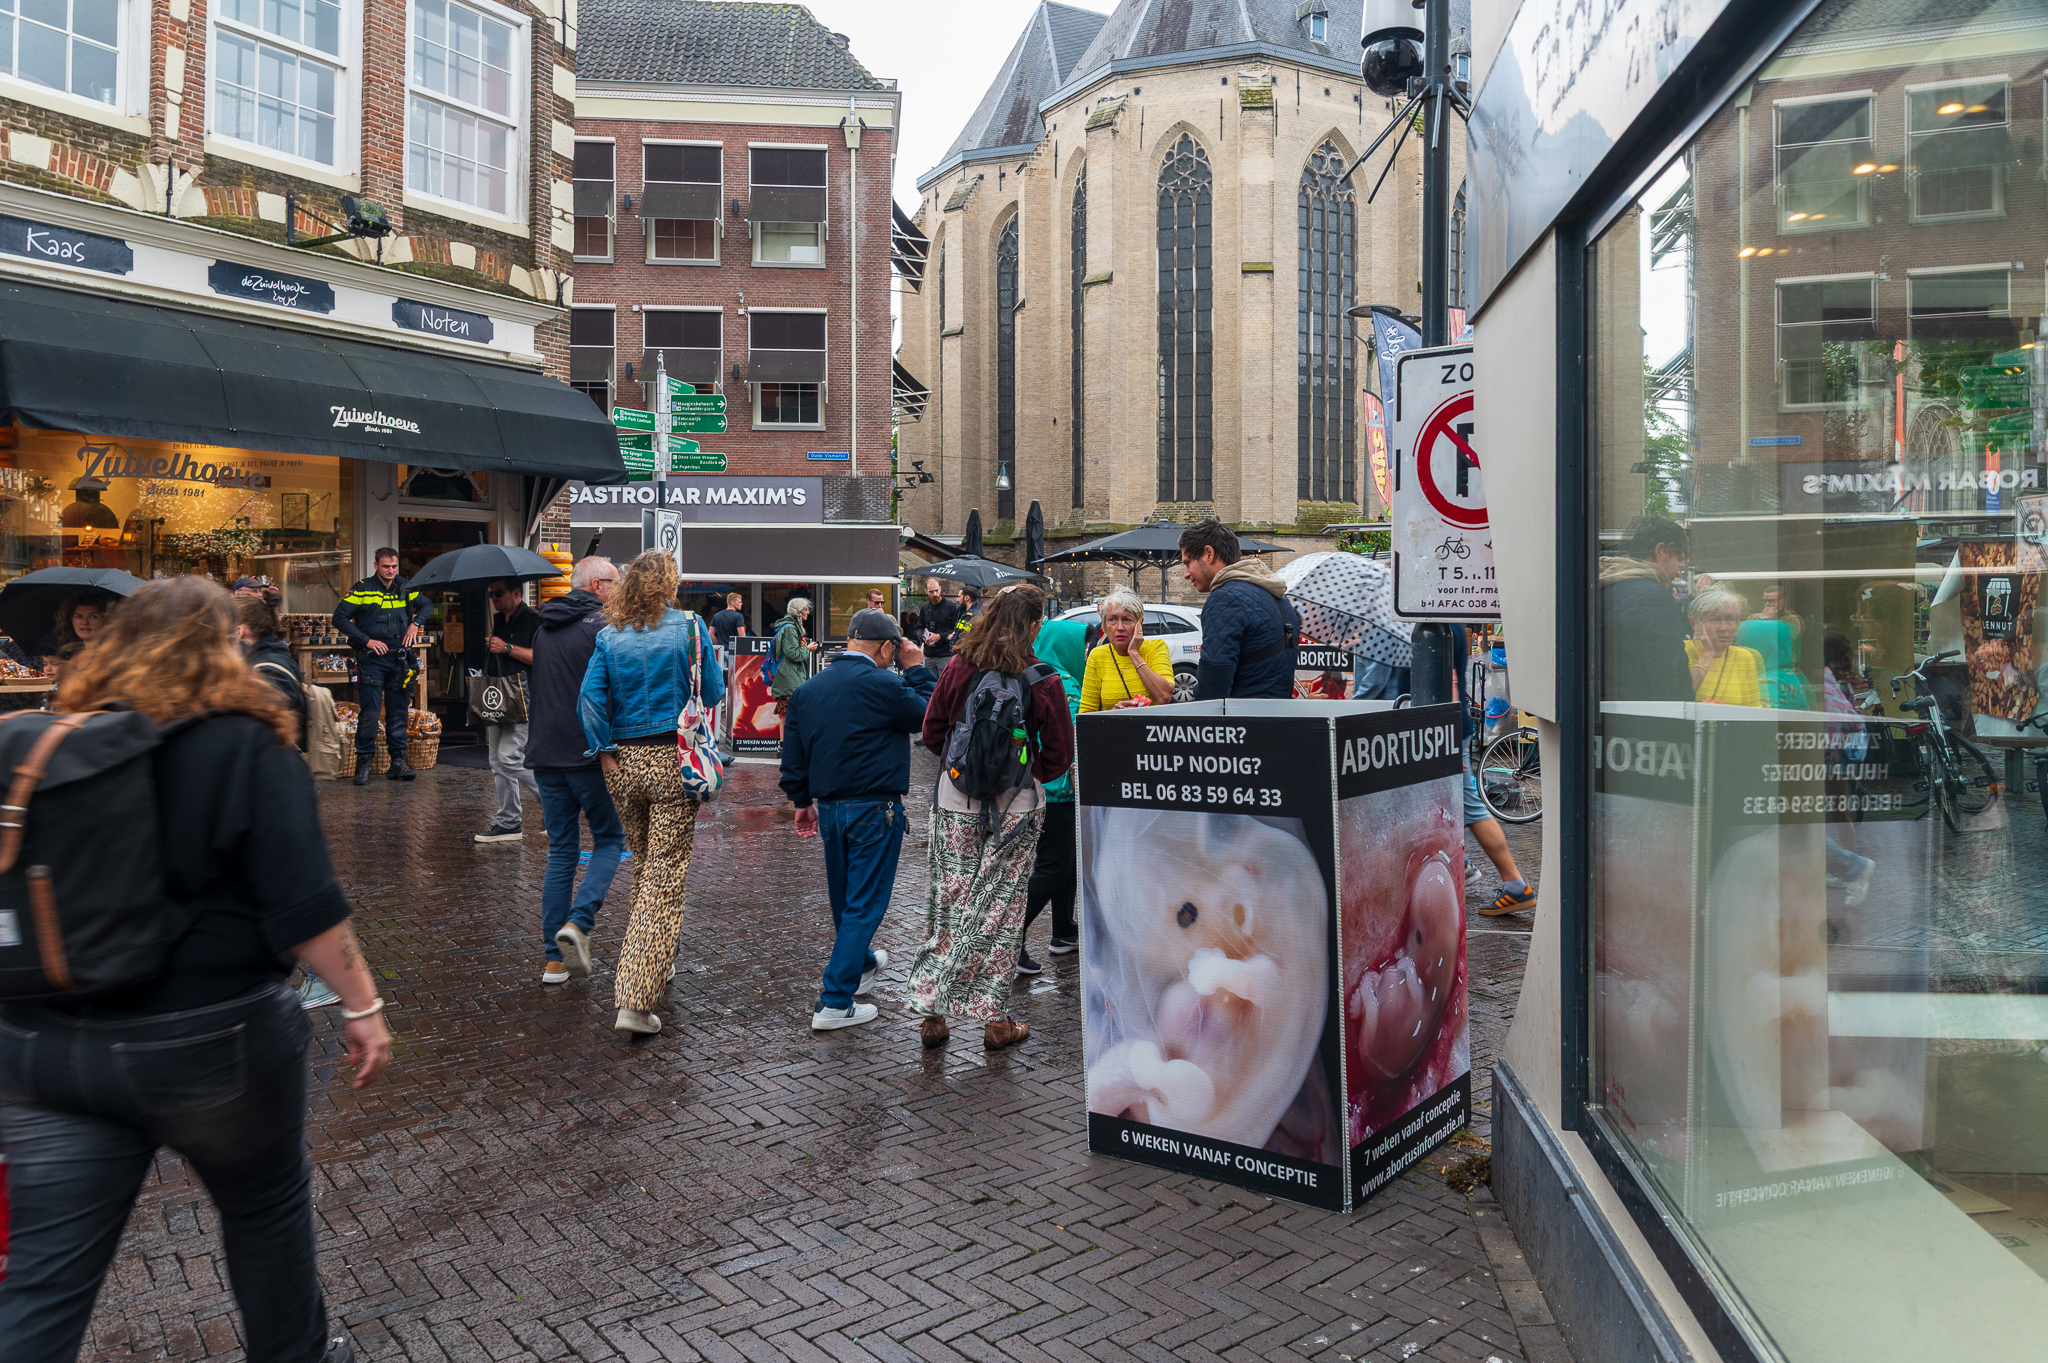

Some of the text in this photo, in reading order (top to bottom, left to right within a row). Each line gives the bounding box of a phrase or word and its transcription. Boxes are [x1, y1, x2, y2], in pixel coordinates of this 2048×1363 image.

[27, 227, 85, 262] Kaas
[421, 309, 469, 336] Noten
[330, 405, 421, 434] Zuivelhoeve
[76, 446, 267, 494] Zuivelhoeve
[1372, 430, 1386, 494] AAS
[146, 483, 205, 498] Sinds 1981
[705, 488, 806, 506] MAXIM'S
[1438, 567, 1448, 580] T
[1438, 600, 1465, 608] AFAC
[1146, 726, 1246, 744] ZWANGER?
[1342, 724, 1460, 775] ABORTUSPIL
[1136, 754, 1261, 775] HULP NODIG?
[1121, 782, 1282, 806] BEL 06 83 59 64 33
[1364, 1089, 1461, 1167] 7 weken vanaf conceptie
[1121, 1129, 1317, 1188] 6 WEKEN VANAF CONCEPTIE
[1361, 1108, 1465, 1197] www.abortusinformatie.nl
